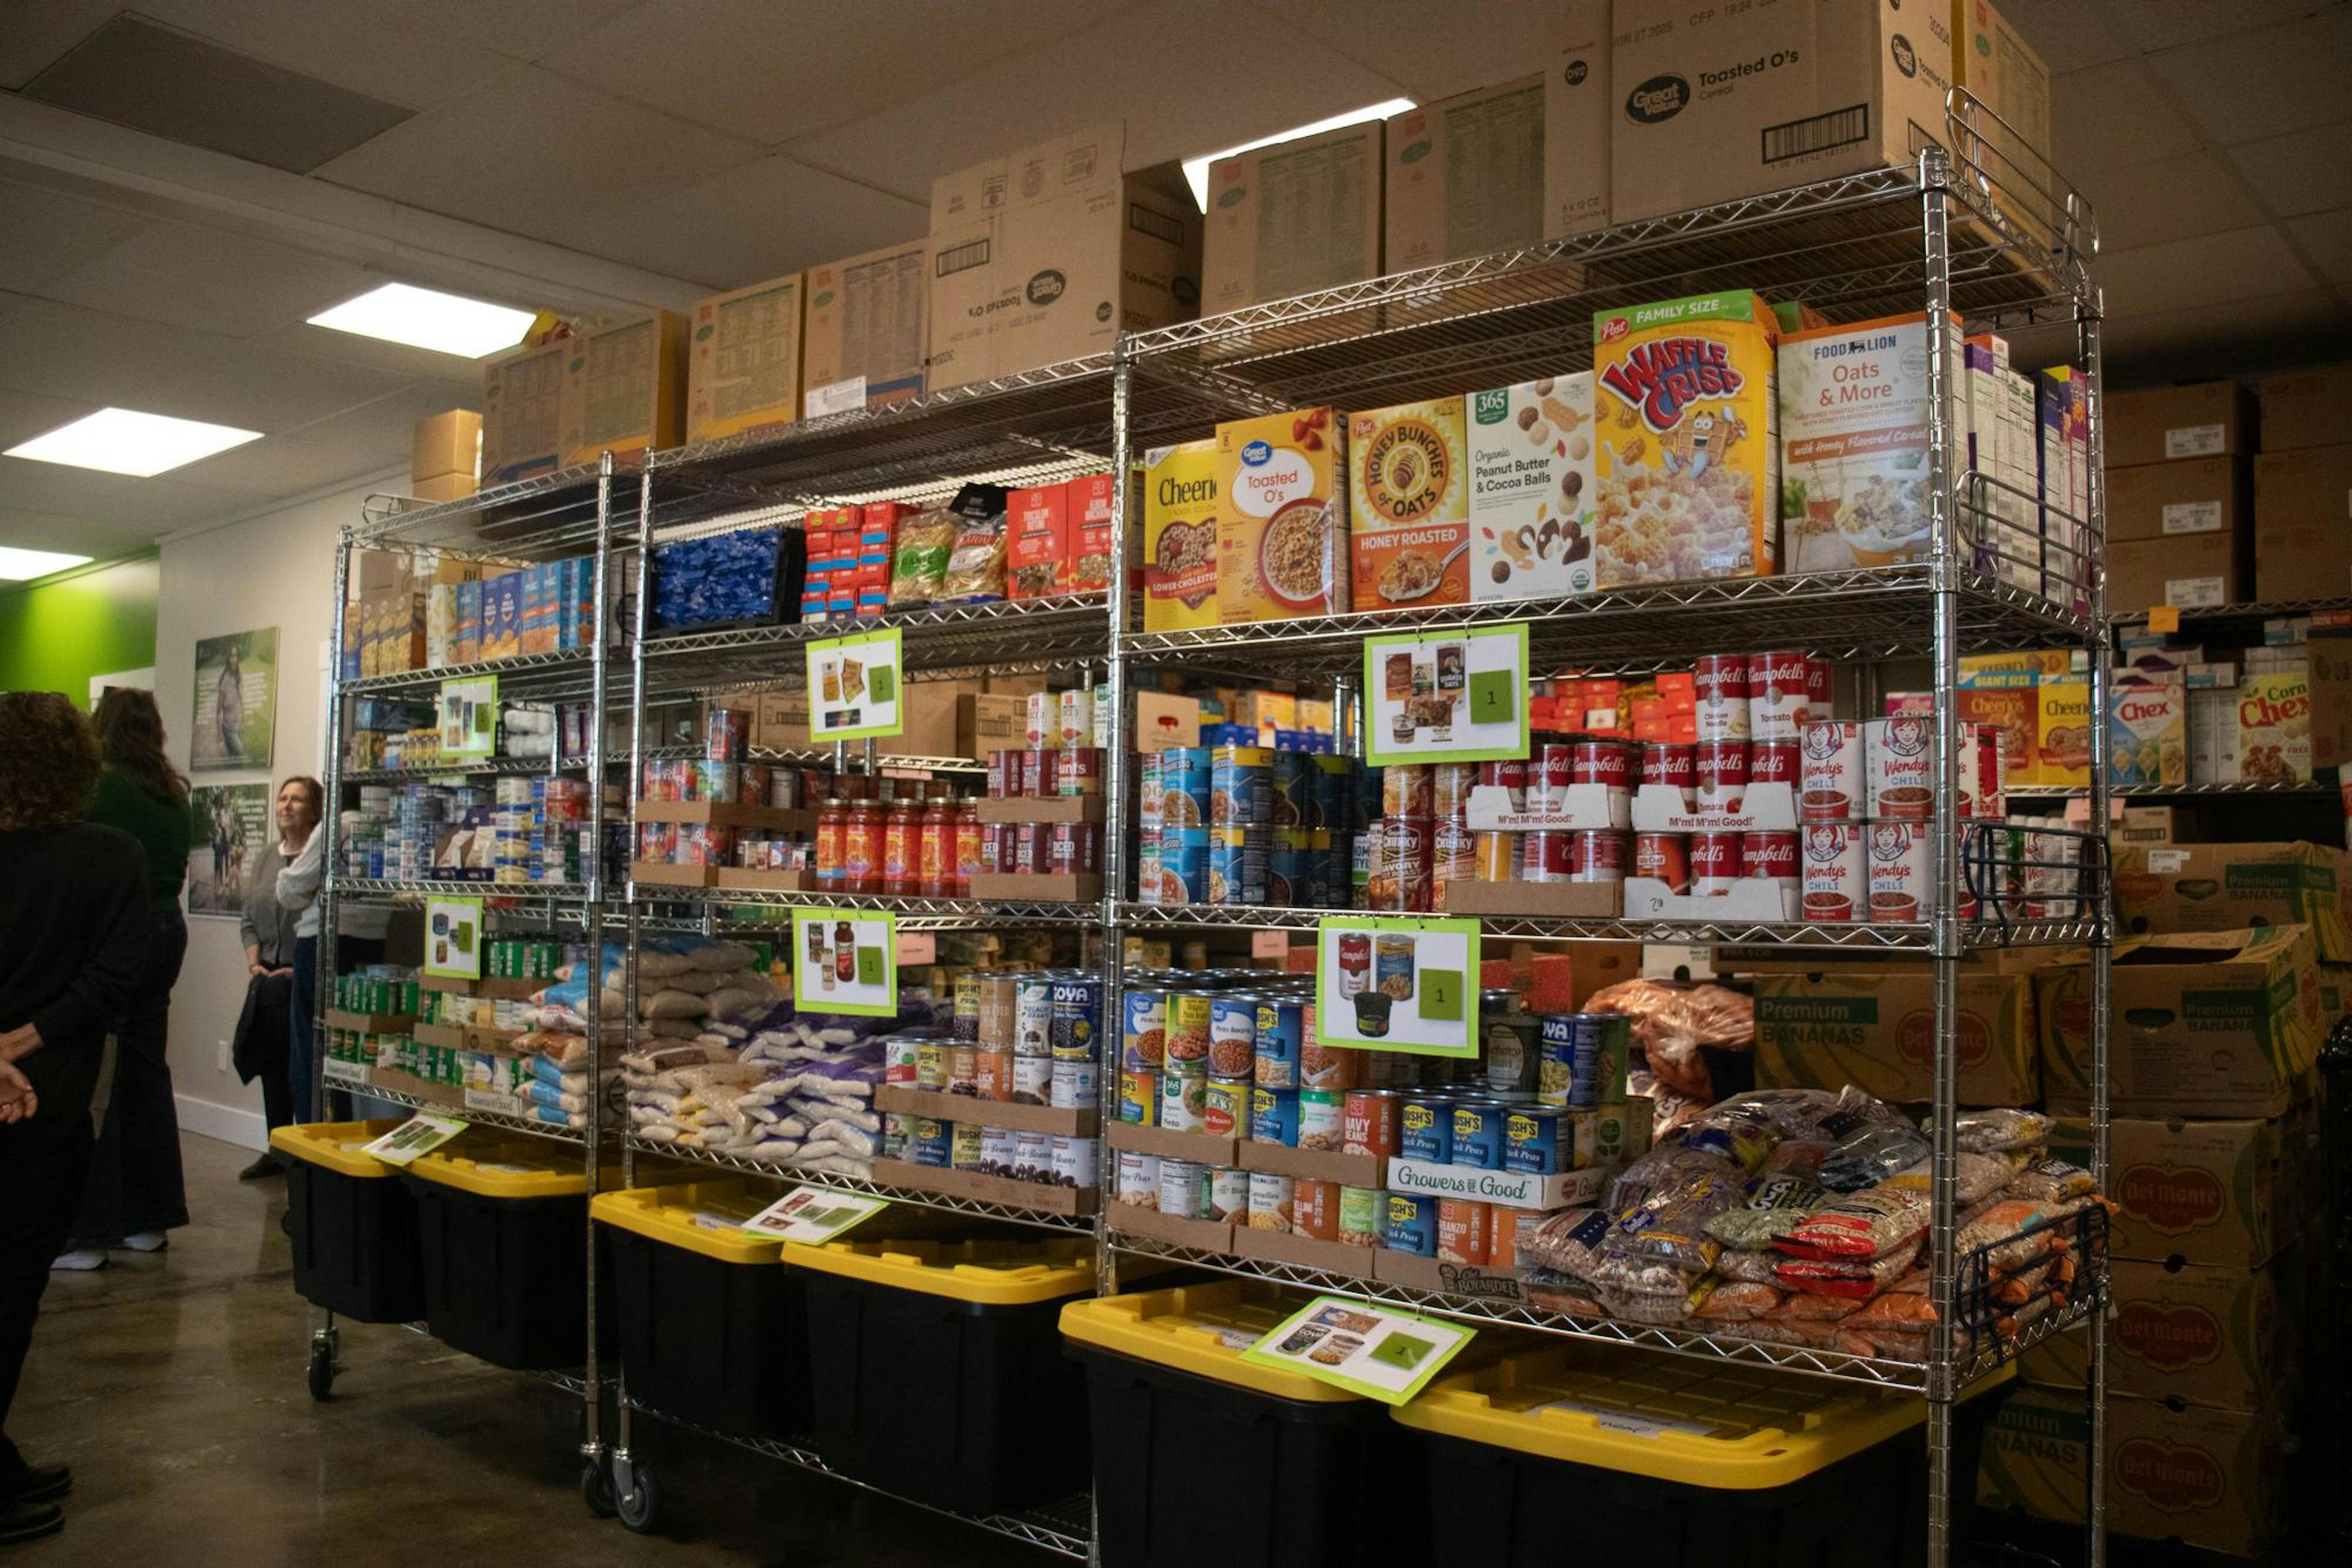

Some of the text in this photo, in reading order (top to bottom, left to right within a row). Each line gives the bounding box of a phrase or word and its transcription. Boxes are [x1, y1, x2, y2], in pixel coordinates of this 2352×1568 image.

[1699, 50, 1799, 87] Toasted O's
[1633, 82, 1680, 108] Great
[1636, 300, 1720, 324] FAMILY SIZE
[1602, 319, 1626, 340] Post
[1814, 336, 1896, 360] FOOD LION
[1602, 338, 1728, 404] WAFFLE
[1833, 362, 1879, 383] Oats
[1478, 392, 1505, 412] 365
[1646, 366, 1742, 430] CRISP
[1820, 384, 1892, 406] & More
[1370, 426, 1444, 486] HONEY BUNCHES
[1475, 449, 1510, 464] Organic
[1795, 443, 1813, 456] with
[1476, 457, 1550, 478] Peanut Butter
[1248, 470, 1298, 489] Toasted
[1477, 472, 1551, 494] & Cocoa Balls
[1159, 474, 1217, 506] Cheeri
[1264, 489, 1285, 503] O's
[1393, 487, 1436, 517] OATS
[1361, 527, 1457, 550] HONEY ROASTED
[1152, 572, 1217, 592] LOWER CHOLESTE
[1748, 663, 1804, 682] Campbell's
[1487, 690, 1496, 706] 1
[2268, 683, 2306, 702] Corn
[2046, 698, 2090, 716] Cheeri
[2121, 701, 2170, 722] Chex
[2239, 695, 2309, 730] Chex
[1760, 713, 1791, 723] Tomato
[1059, 763, 1087, 774] unt's
[1804, 761, 1843, 778] Wendy's
[1884, 757, 1929, 777] Wendy's
[1806, 780, 1836, 789] CHILI
[1890, 777, 1925, 786] CHILI
[1498, 814, 1572, 824] M'm! M'm! Good!
[1669, 816, 1752, 827] M'm! M'm! Good!
[1742, 844, 1793, 864] ampbell's
[1806, 862, 1846, 881] Wendy's
[1870, 861, 1910, 881] Wendy's
[2229, 874, 2288, 887] Premium
[1809, 881, 1839, 890] CHILI
[1873, 881, 1904, 890] CHILI
[868, 961, 873, 972] 1
[1436, 988, 1445, 1002] 1
[1763, 1003, 1850, 1020] Premium
[2186, 1005, 2254, 1017] Premium
[1763, 1025, 1865, 1045] BANANAS
[1404, 1110, 1432, 1126] USH'S
[1509, 1121, 1536, 1136] USH'S
[1416, 1137, 1435, 1150] Peas
[1464, 1143, 1484, 1156] Peas
[1520, 1149, 1541, 1162] Peas
[1398, 1165, 1527, 1199] Growers OF Good
[2126, 1182, 2217, 1206] Del Monte
[1458, 1278, 1518, 1298] BOYARDEE
[2123, 1320, 2213, 1345] Del Monte
[2154, 1462, 2215, 1488] Monte
